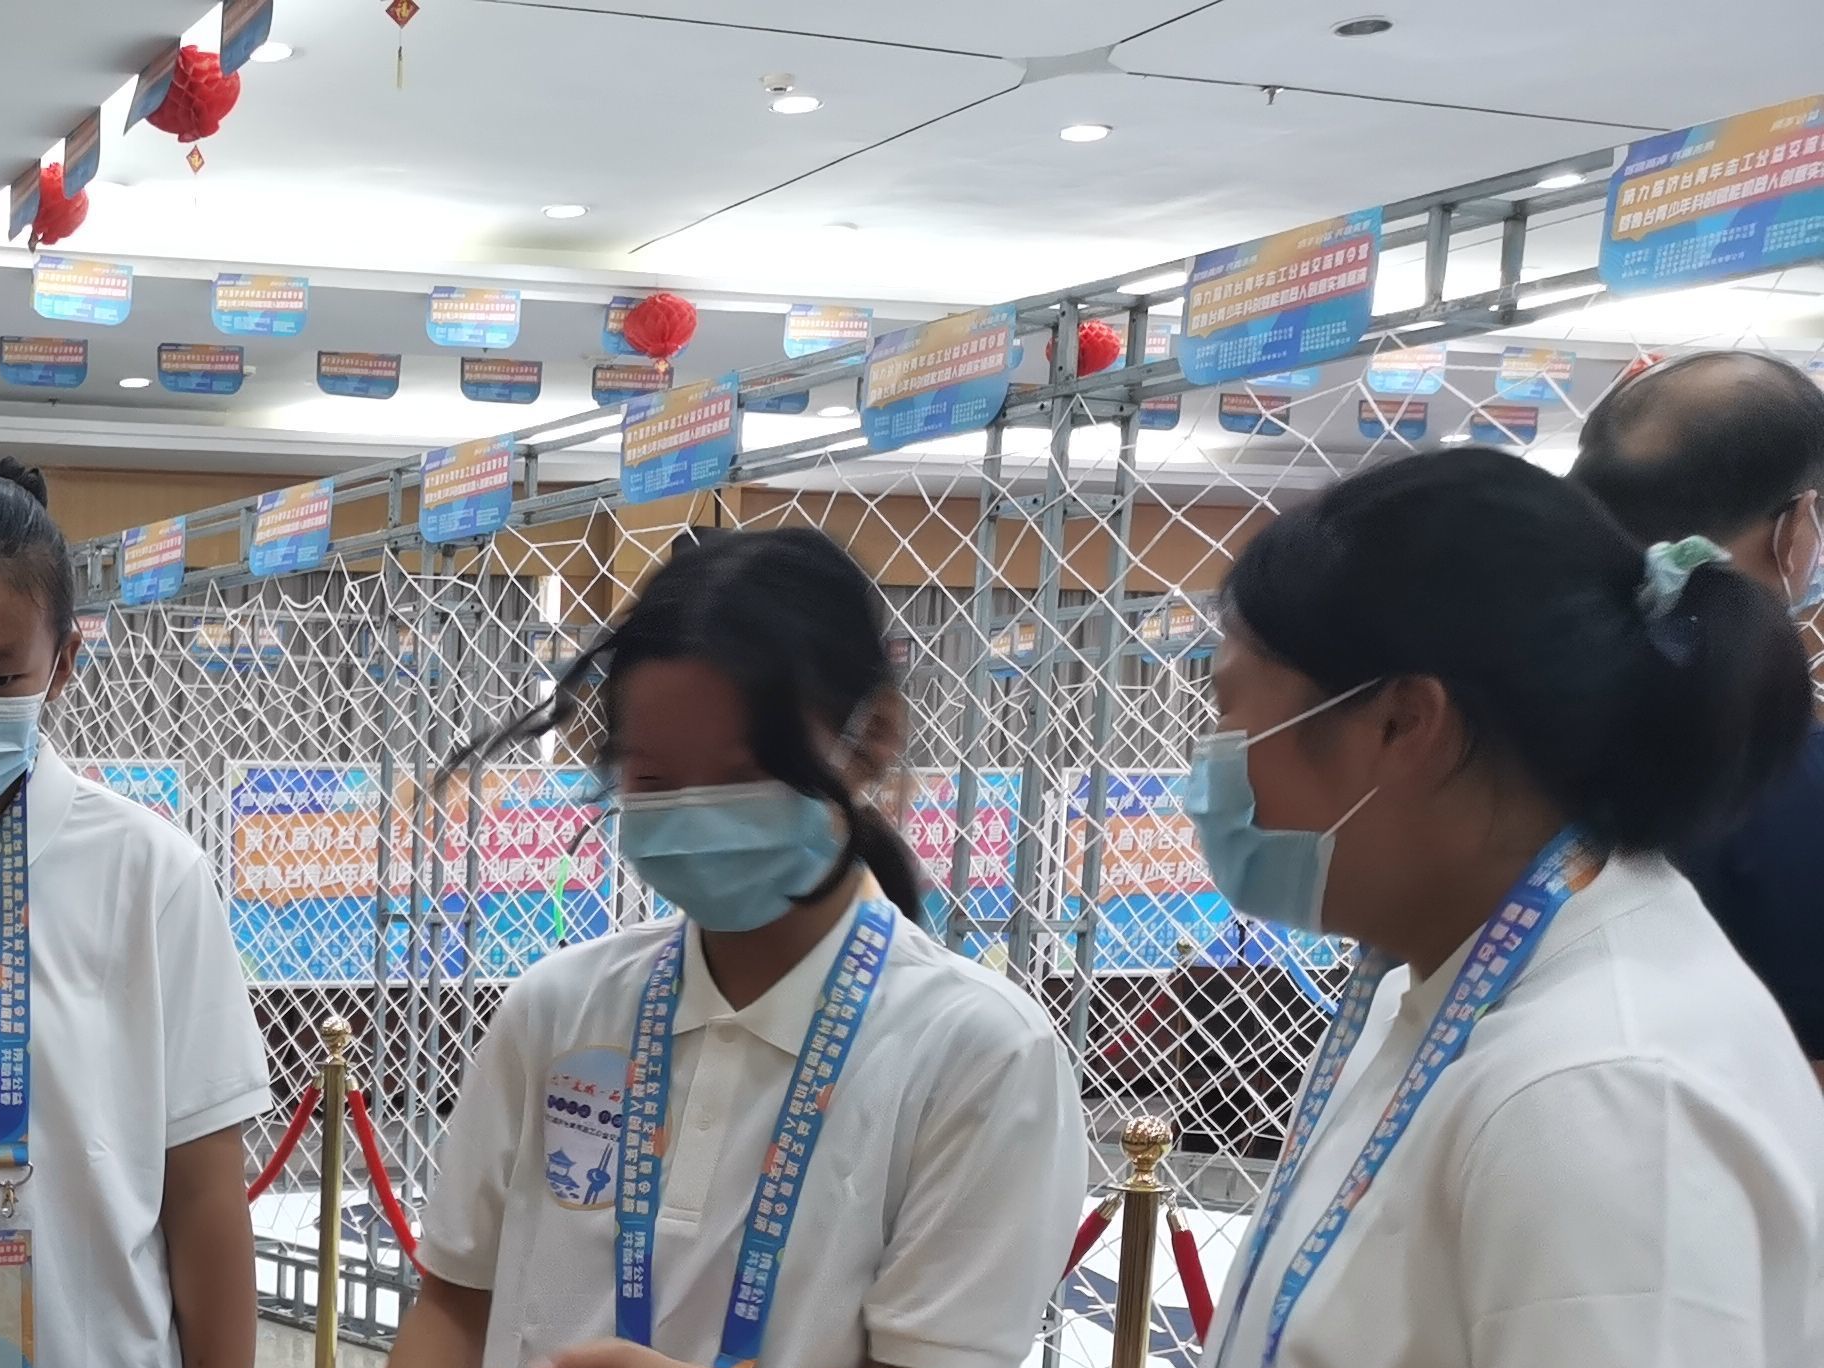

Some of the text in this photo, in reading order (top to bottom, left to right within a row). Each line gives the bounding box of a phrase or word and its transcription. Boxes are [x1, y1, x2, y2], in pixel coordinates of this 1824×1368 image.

[1622, 134, 1824, 207] 第九届济台青年志工公益交流
